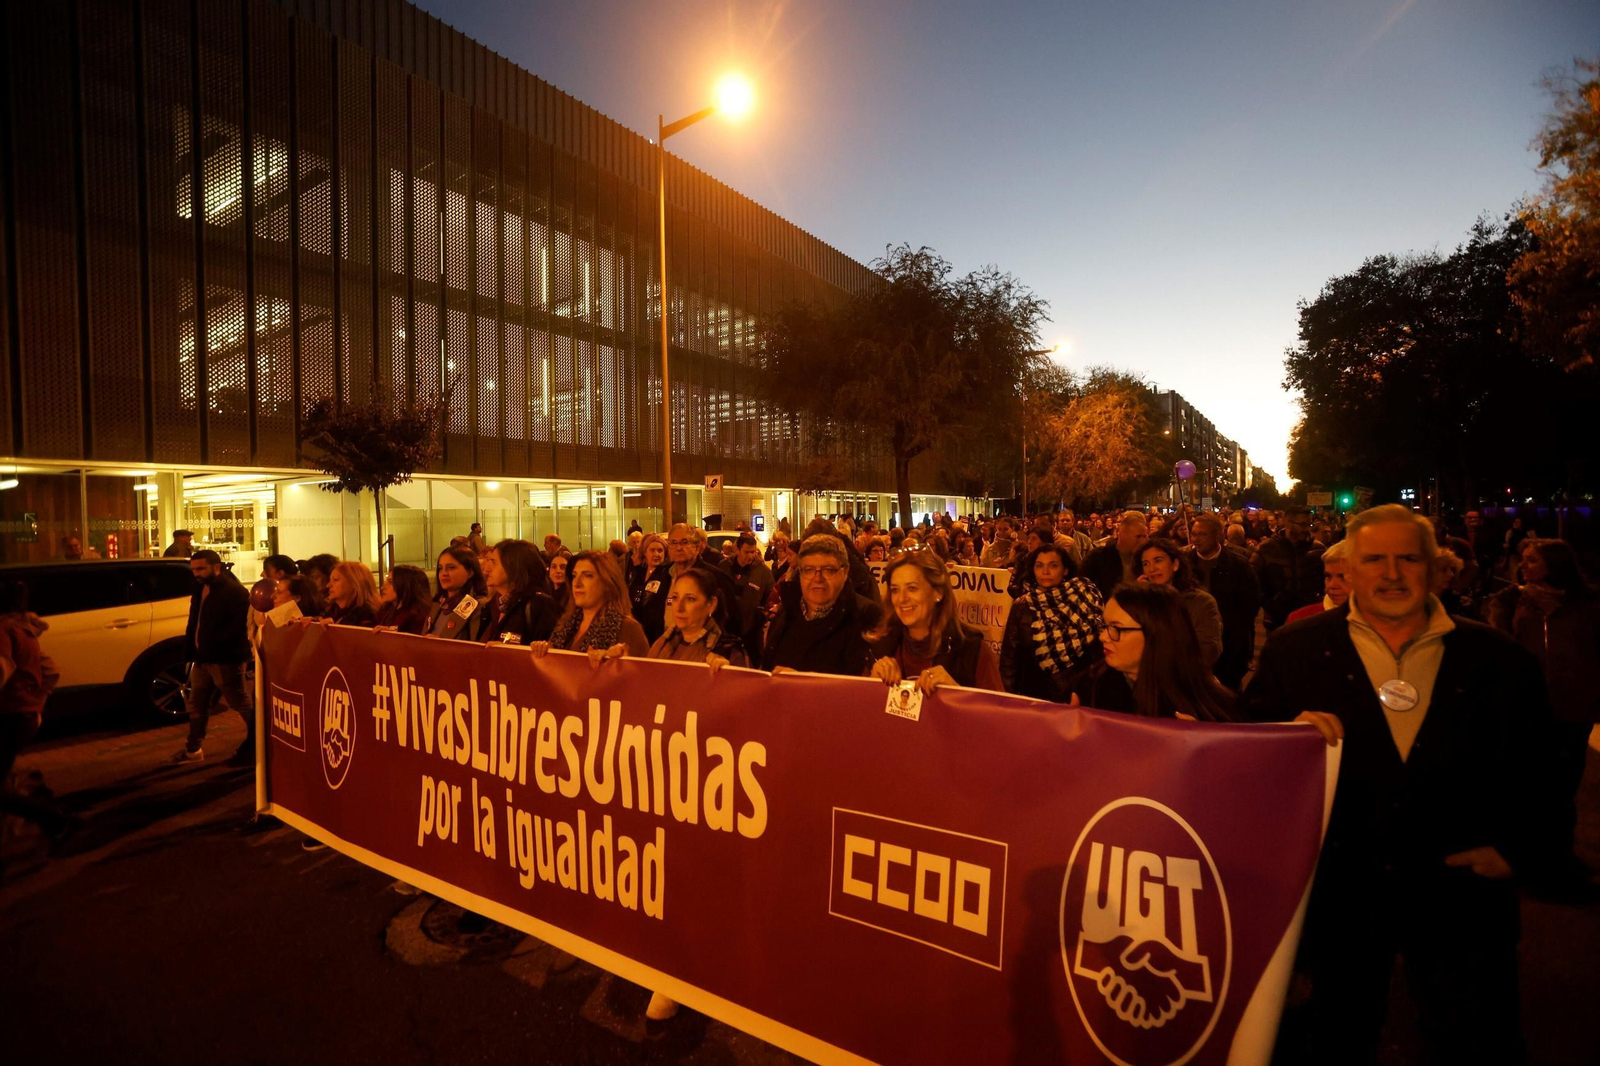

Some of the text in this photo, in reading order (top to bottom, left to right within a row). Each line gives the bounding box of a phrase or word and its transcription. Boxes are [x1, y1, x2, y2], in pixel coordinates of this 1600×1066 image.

[950, 571, 1004, 593] ONAL
[272, 695, 301, 738] CCOO
[324, 687, 350, 739] UGT
[371, 662, 768, 839] #VivasLibresUnidas
[888, 708, 917, 720] JUSTICIA
[417, 774, 666, 920] por la igualdad
[842, 833, 991, 937] CCOO
[1080, 841, 1203, 957] UGT
